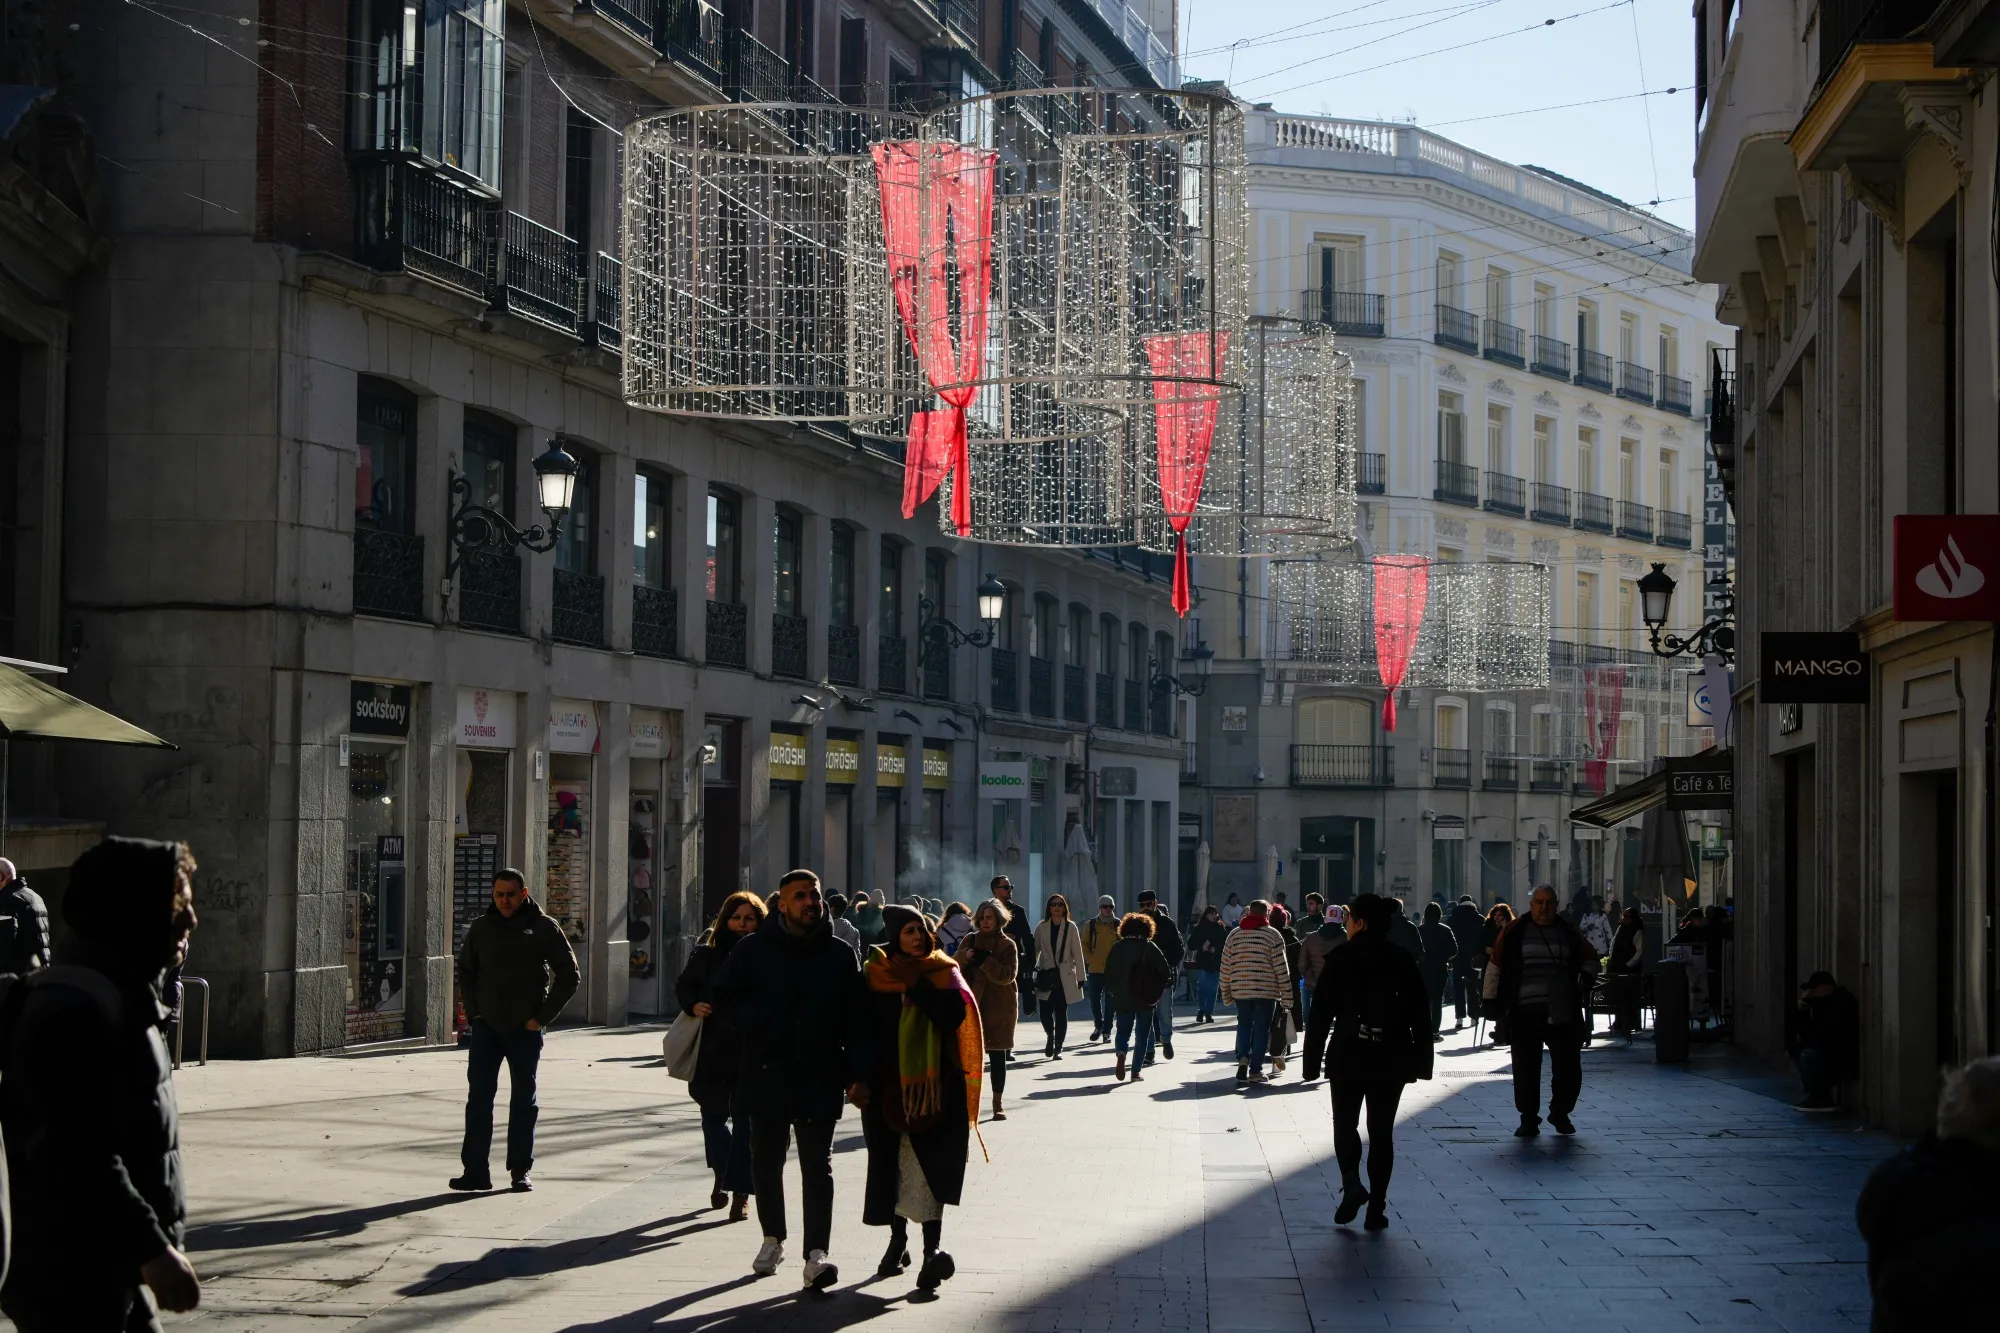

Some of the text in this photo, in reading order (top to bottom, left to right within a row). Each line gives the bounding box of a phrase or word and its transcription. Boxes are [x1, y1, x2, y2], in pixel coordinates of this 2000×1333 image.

[1774, 659, 1862, 676] MANGO
[356, 697, 406, 725] sockstory
[464, 724, 496, 738] SOUVENIRS
[1706, 779, 1715, 791] &
[383, 837, 402, 855] ATM
[1318, 834, 1326, 844] 4
